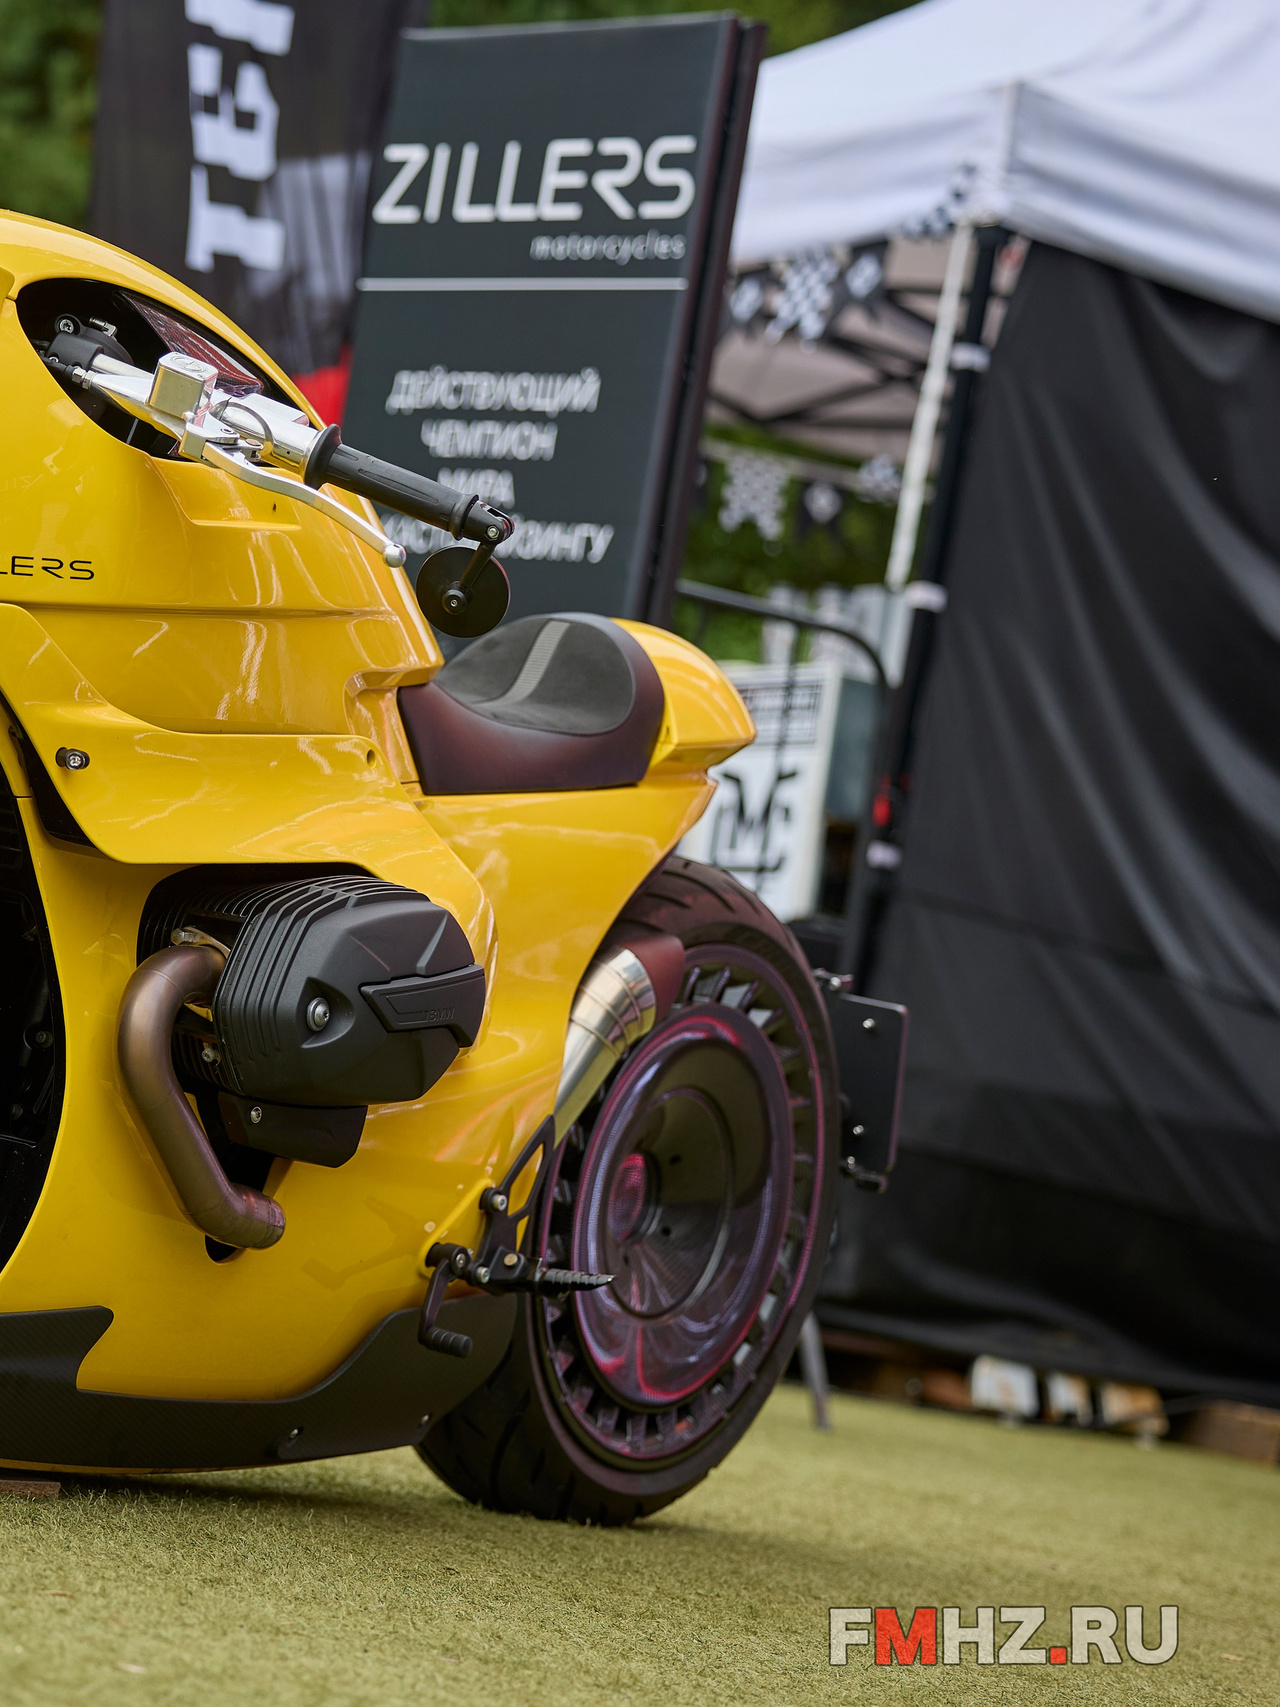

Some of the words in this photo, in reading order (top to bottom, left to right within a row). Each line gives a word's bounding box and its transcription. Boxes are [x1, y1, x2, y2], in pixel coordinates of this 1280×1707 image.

[372, 135, 697, 224] ZILLERS
[530, 228, 687, 266] motorcycles
[385, 364, 601, 418] ДЕЙСТВУЮЩИЙ
[421, 419, 558, 461] ЧЕМПИОН
[428, 1005, 456, 1022] BMW
